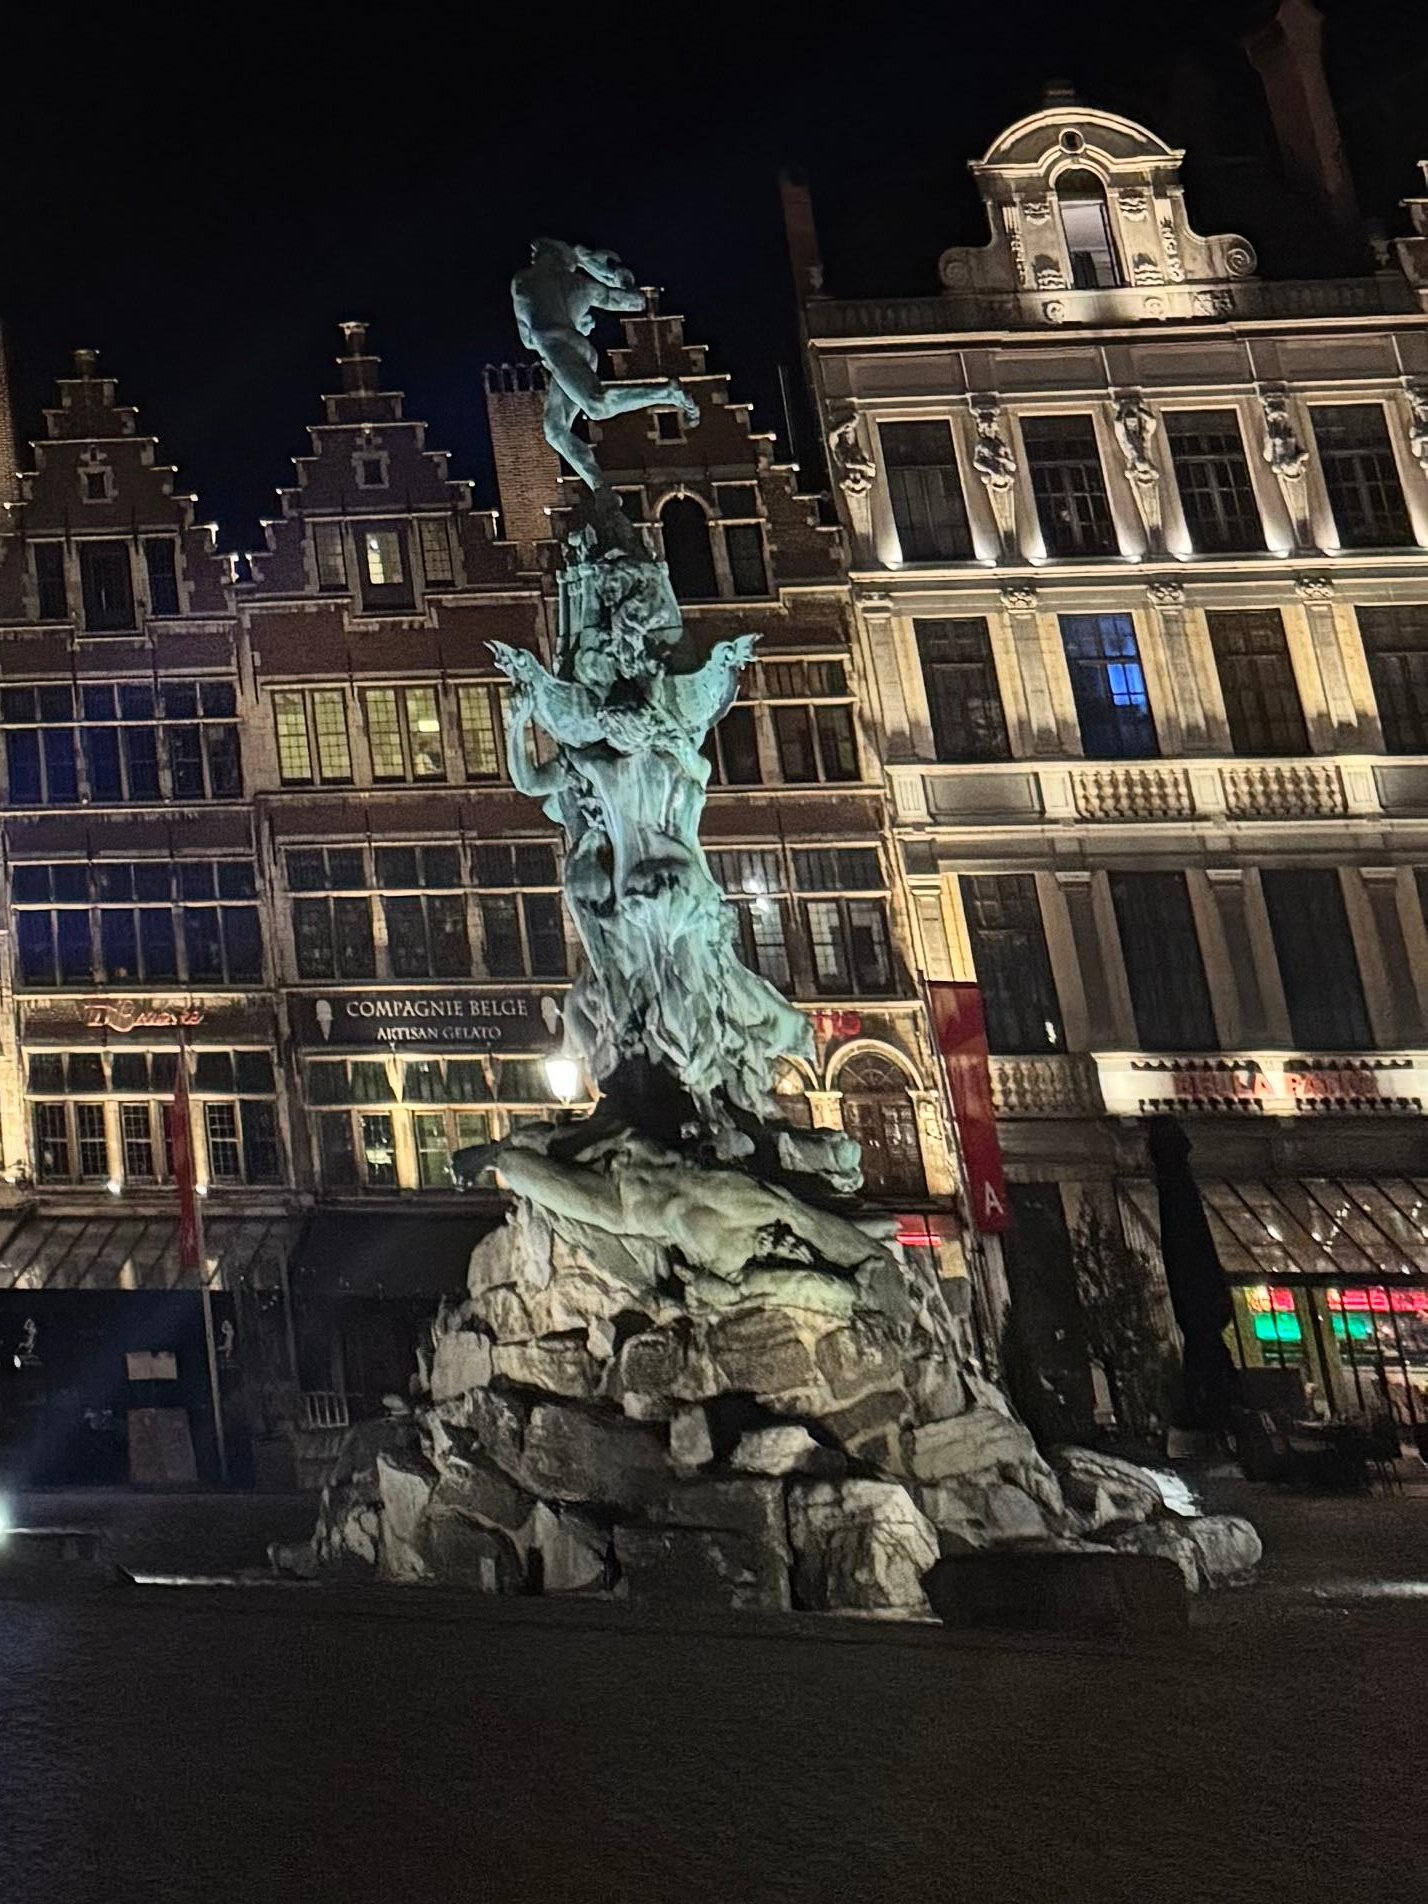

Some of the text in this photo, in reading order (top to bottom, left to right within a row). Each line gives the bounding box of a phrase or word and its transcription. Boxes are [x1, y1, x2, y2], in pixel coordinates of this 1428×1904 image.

[347, 998, 529, 1018] COMPAGNIE BELGE
[377, 1026, 502, 1041] ARTISAN GELATO
[984, 1180, 1004, 1215] A
